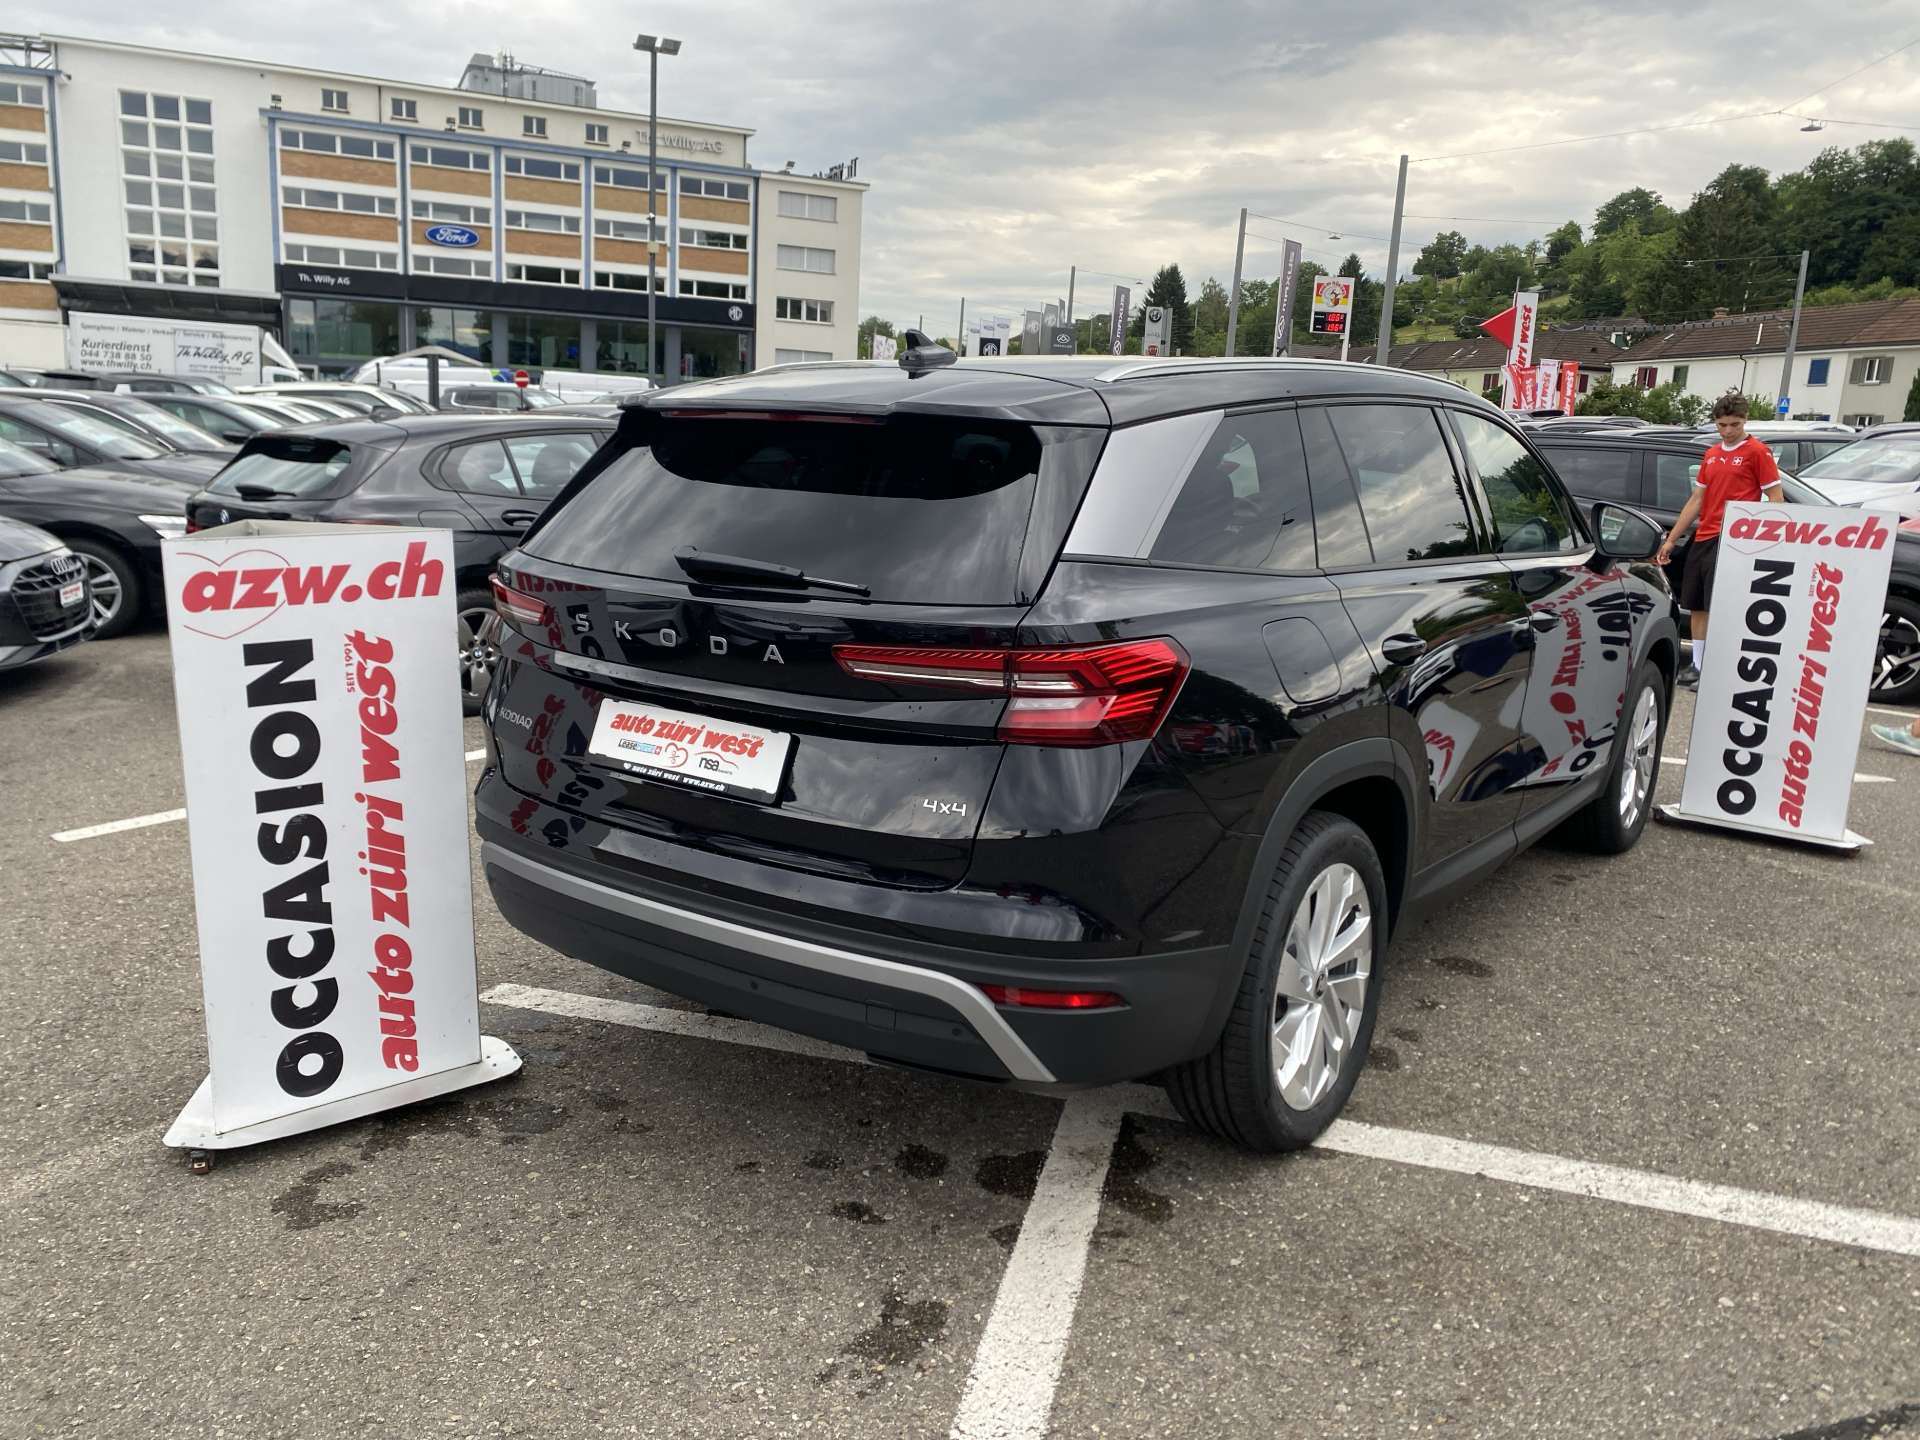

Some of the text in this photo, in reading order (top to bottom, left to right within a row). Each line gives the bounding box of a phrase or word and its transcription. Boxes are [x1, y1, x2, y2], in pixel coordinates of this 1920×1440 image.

[663, 135, 696, 153] Willy
[436, 227, 469, 244] Ford
[298, 273, 351, 287] Th. Willy AG
[1520, 304, 1532, 343] west
[80, 350, 101, 359] 044
[122, 352, 136, 360] 88
[81, 339, 151, 352] Kurierdienst
[1729, 516, 1889, 550] azw.ch
[182, 541, 444, 613] azw.ch
[346, 671, 355, 693] SEIT
[1716, 559, 1796, 815] OCCASION
[1778, 561, 1844, 828] auto züri west
[499, 706, 533, 729] KODIAQ
[610, 713, 765, 758] auto züri west
[699, 757, 720, 772] nsa
[631, 765, 647, 775] auto
[663, 771, 680, 782] west
[682, 776, 726, 792] www.azw.ch
[923, 799, 967, 817] 4x4
[344, 630, 419, 1072] auto züri west
[243, 638, 344, 1097] OCCASION
